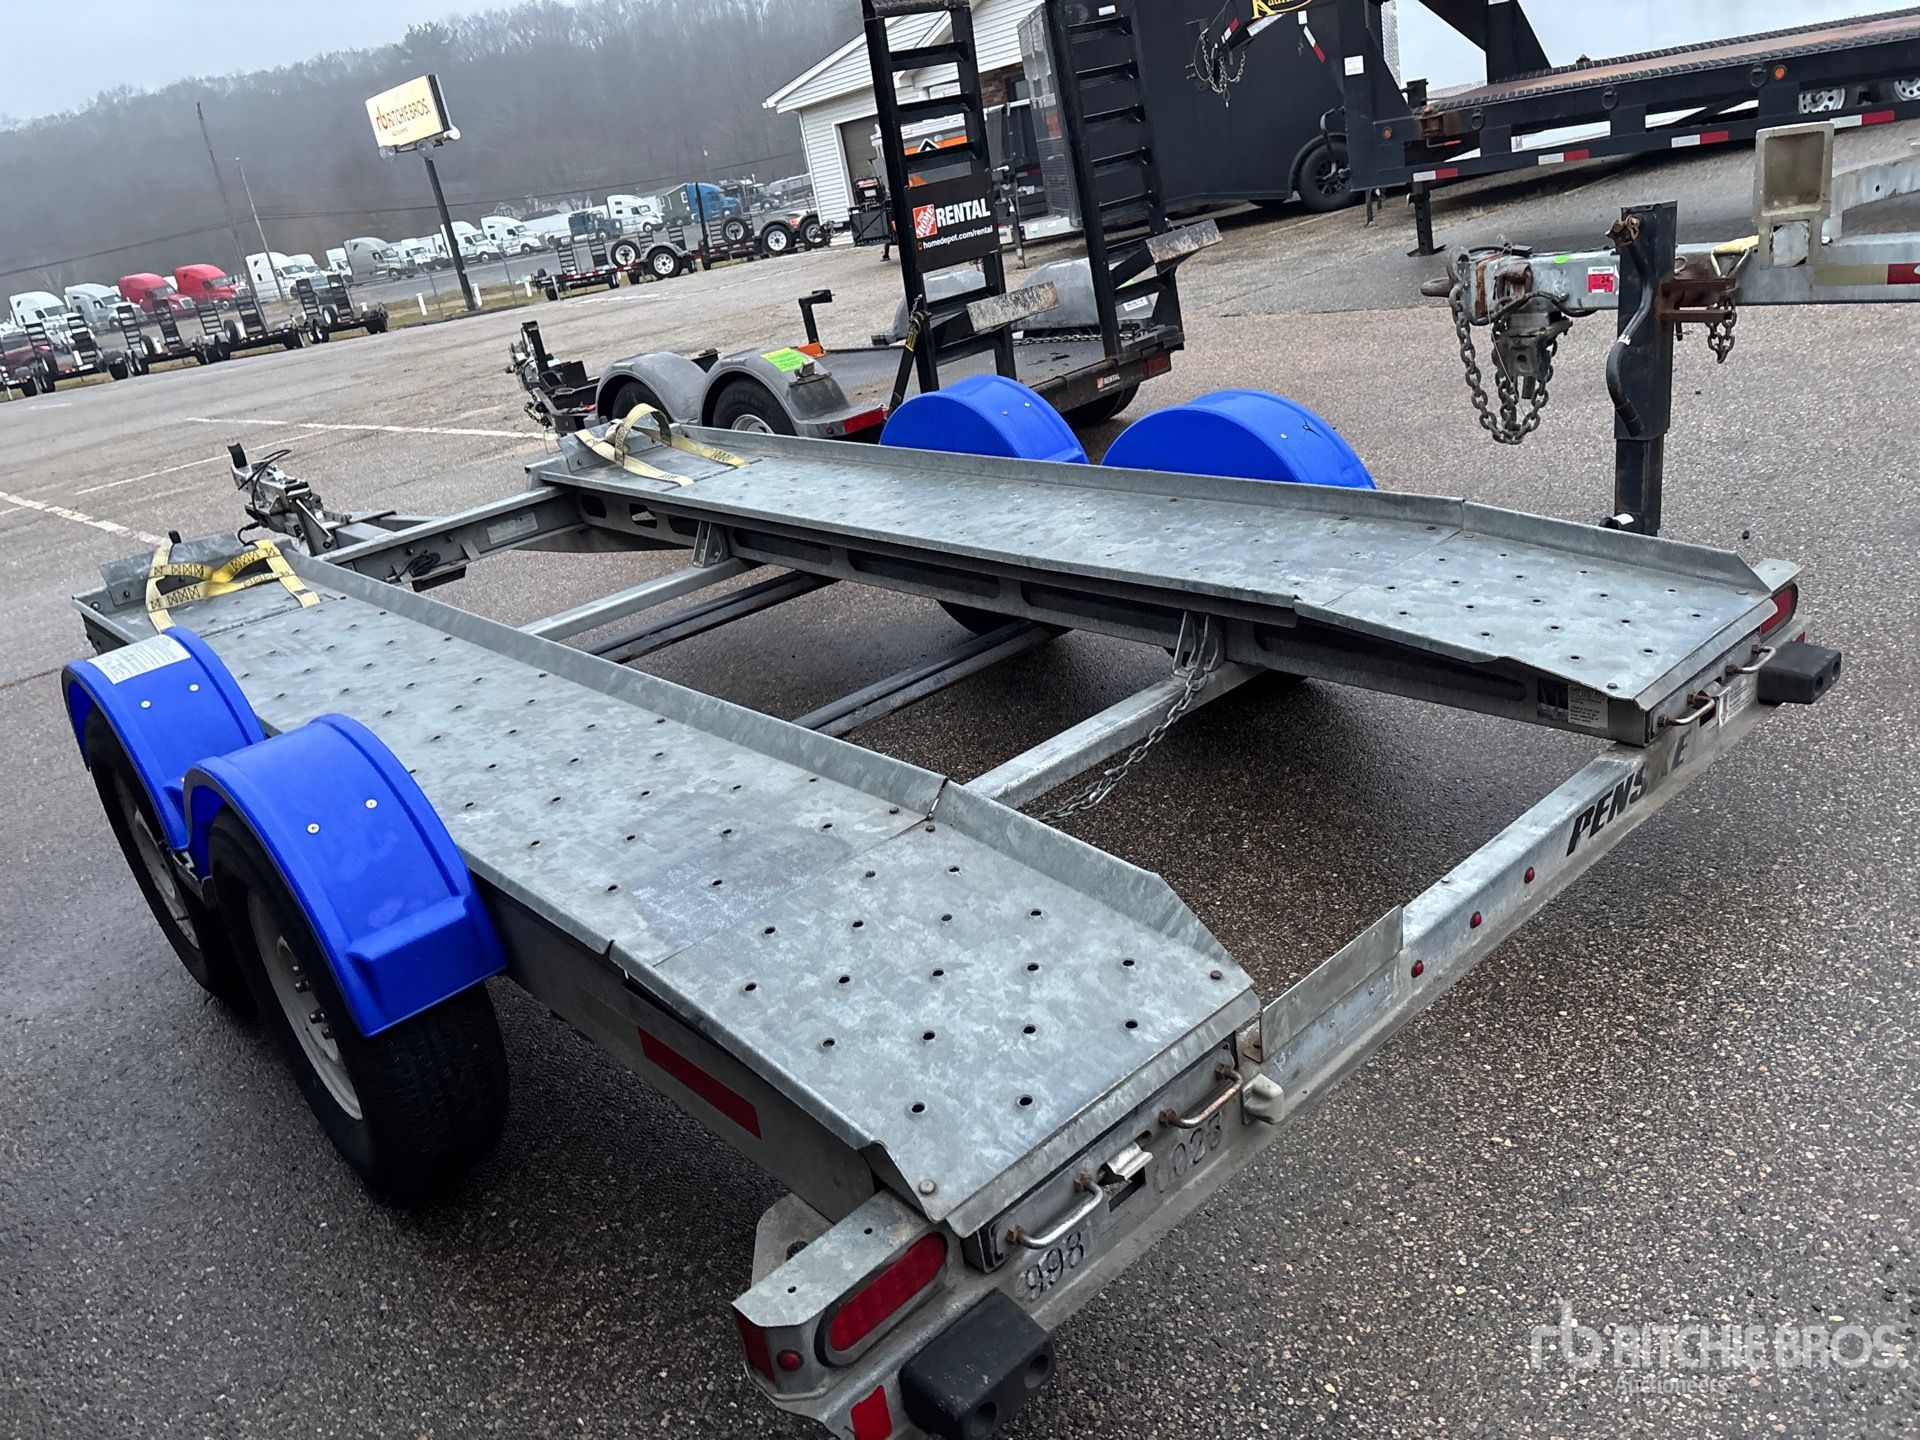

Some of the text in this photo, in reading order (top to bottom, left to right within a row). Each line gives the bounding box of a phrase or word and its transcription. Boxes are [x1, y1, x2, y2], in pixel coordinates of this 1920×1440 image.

[915, 204, 935, 237] HOME
[935, 198, 991, 228] RENTAL
[922, 225, 994, 250] homedepot.com/rental
[1565, 727, 1693, 858] PENSE
